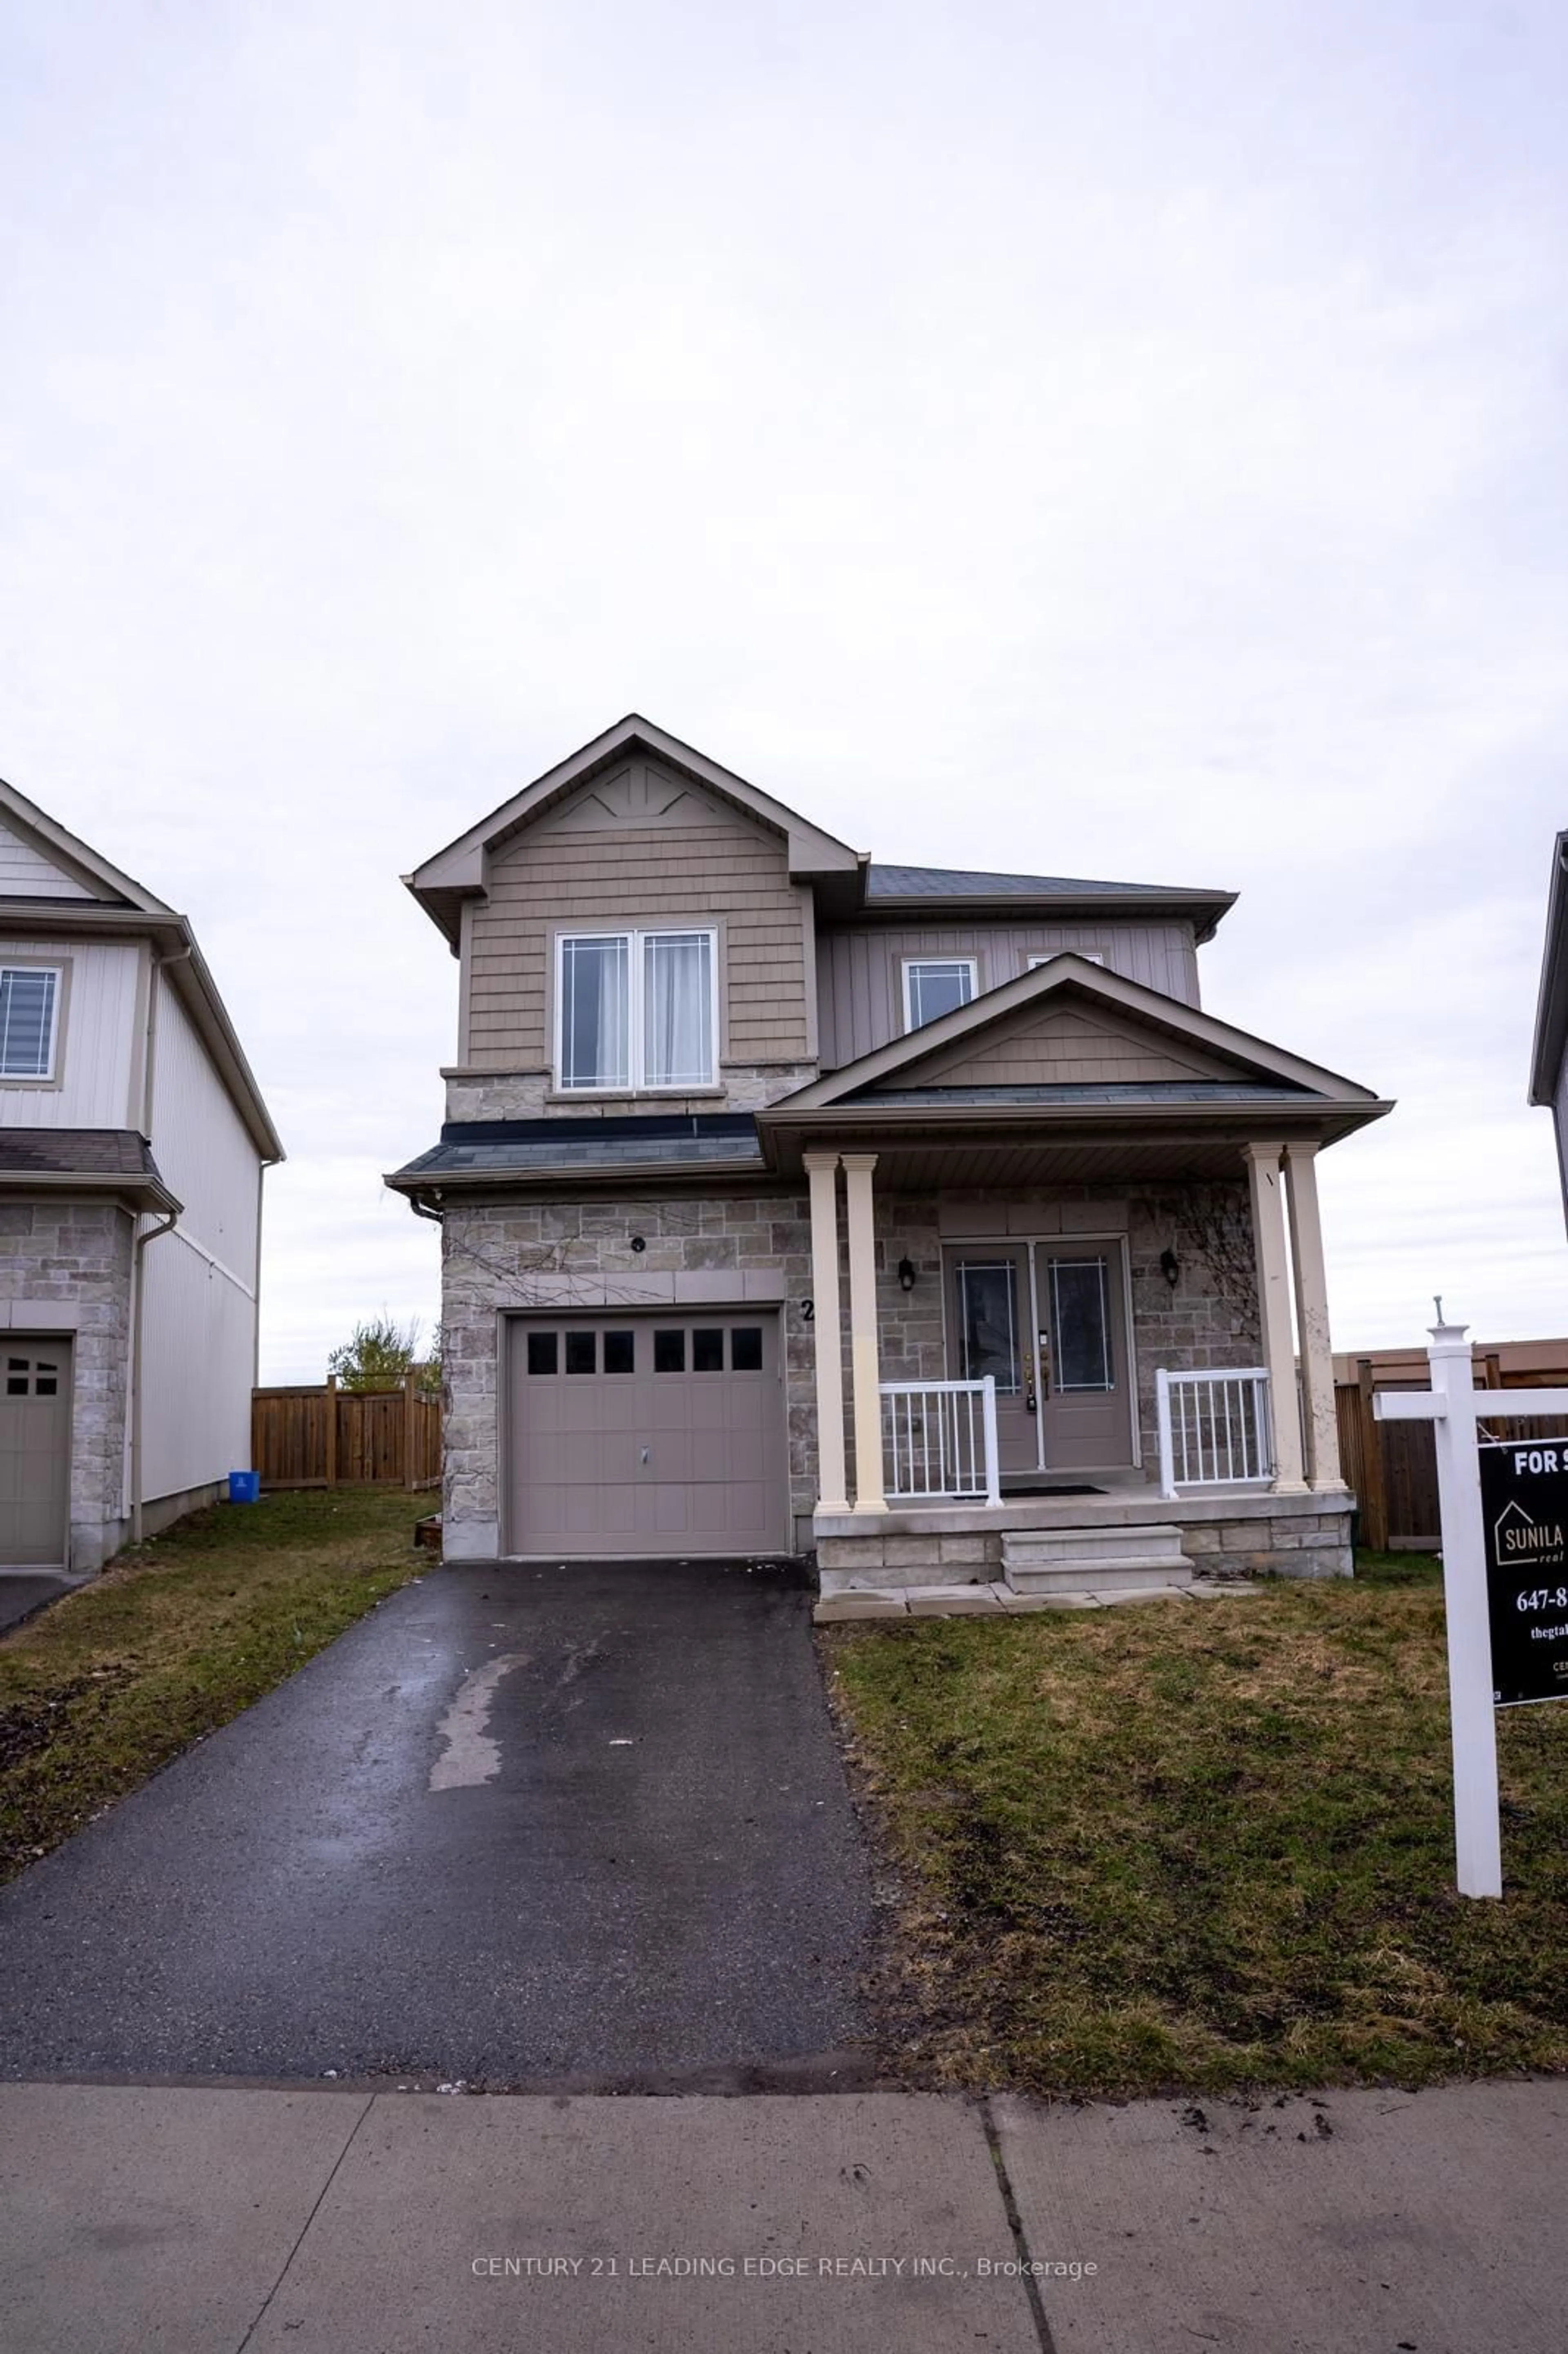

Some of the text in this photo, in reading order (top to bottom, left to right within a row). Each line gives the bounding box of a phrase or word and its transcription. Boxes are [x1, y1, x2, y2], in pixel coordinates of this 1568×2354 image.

[802, 1300, 814, 1321] 2
[1515, 1450, 1559, 1475] FOR
[1506, 1525, 1564, 1550] SUNILA
[1540, 1551, 1564, 1563] real
[1517, 1587, 1568, 1612] 647-8
